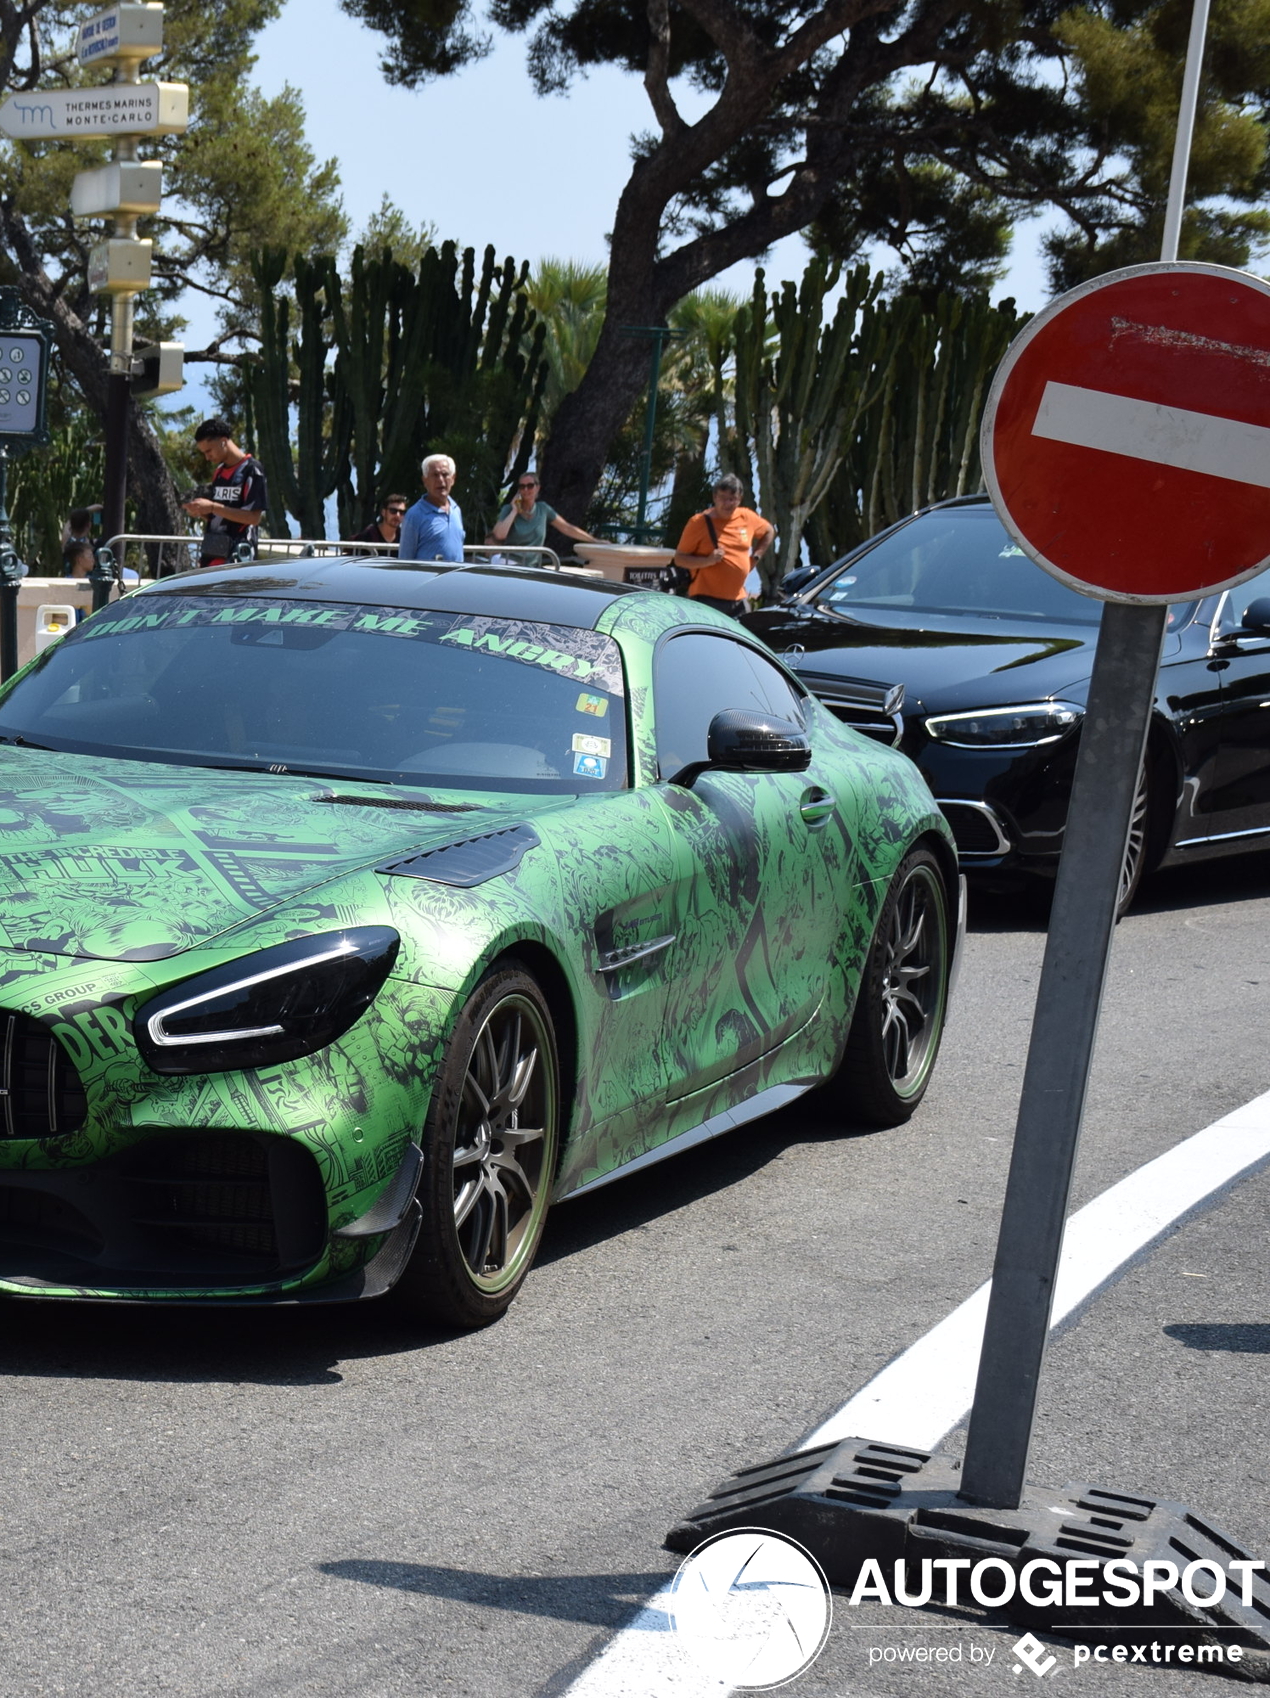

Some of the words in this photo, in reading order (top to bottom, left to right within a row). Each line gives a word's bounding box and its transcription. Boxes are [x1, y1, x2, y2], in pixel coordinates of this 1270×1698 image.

[65, 101, 112, 112] THERMES
[114, 97, 153, 109] MARINS
[83, 607, 207, 640] DON'T
[210, 606, 346, 627] MAKE
[353, 613, 434, 637] ME
[437, 627, 606, 680] ANGRY
[584, 703, 599, 713] 21
[1, 849, 48, 865] THE
[50, 845, 187, 862] INCREDIBLE
[9, 858, 203, 883] HULK
[44, 983, 98, 1005] GROUP
